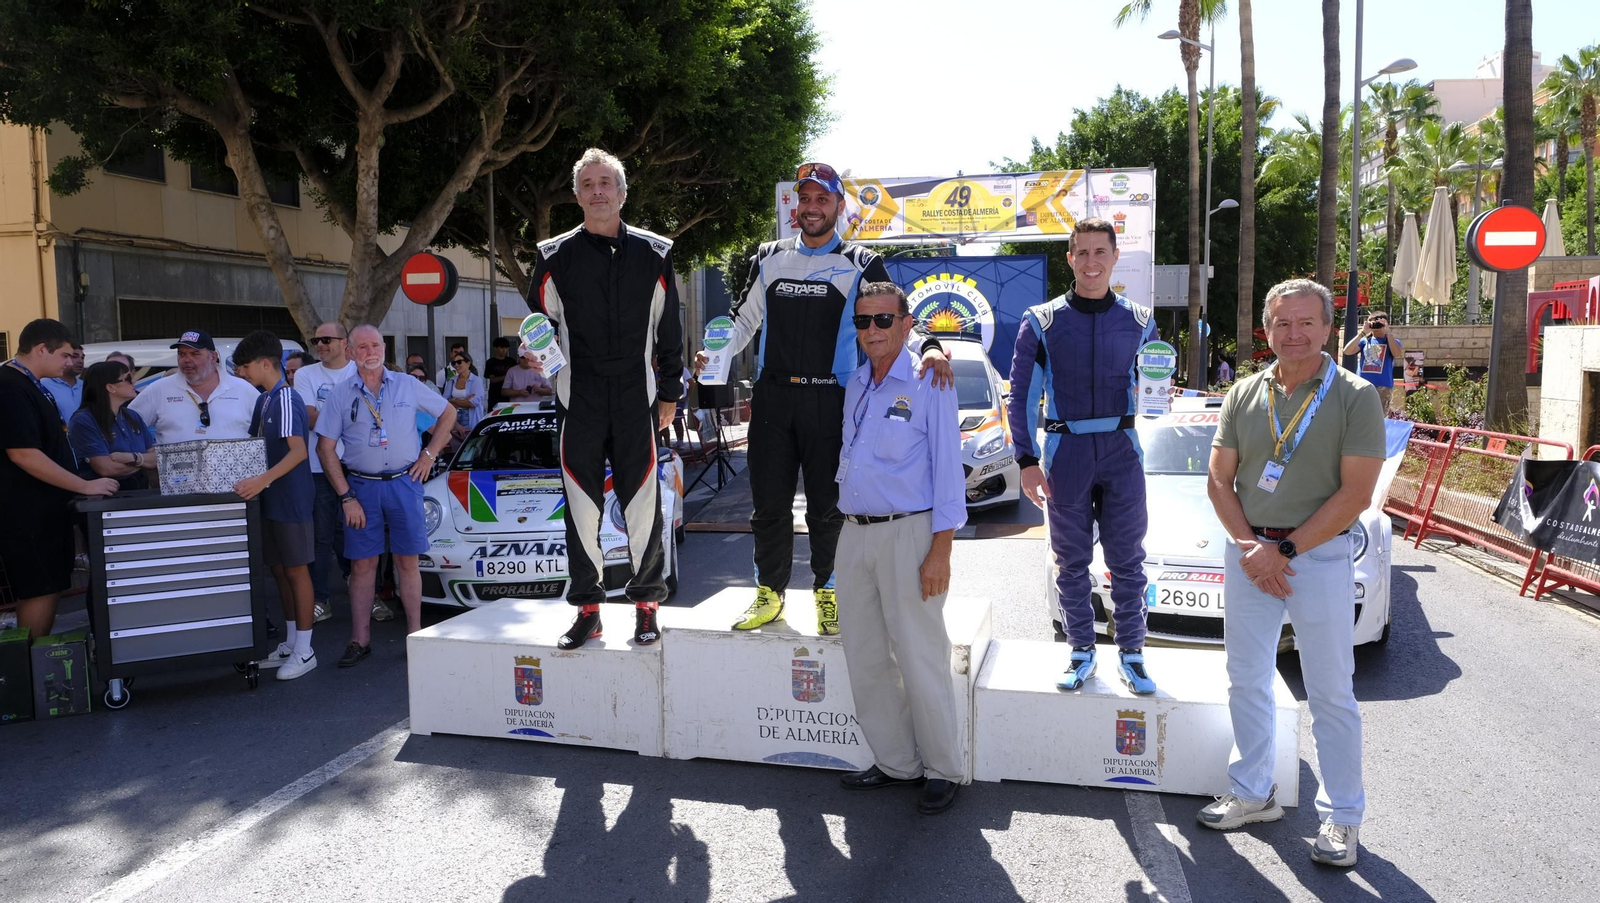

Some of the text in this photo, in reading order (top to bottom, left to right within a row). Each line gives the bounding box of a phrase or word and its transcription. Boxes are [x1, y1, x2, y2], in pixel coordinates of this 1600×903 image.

[944, 185, 972, 208] 49
[922, 206, 999, 217] RALLYE COSTA DE ALMERÍA
[859, 224, 892, 232] ALMERÍA
[543, 245, 556, 253] OMP
[652, 242, 665, 251] OMP
[775, 281, 828, 294] ASTARS
[908, 283, 988, 316] UTOMOVIL CLUB
[526, 322, 549, 342] Rally
[707, 328, 729, 339] Rally
[531, 331, 551, 347] Challenge
[1143, 354, 1172, 368] Rally
[1142, 366, 1171, 374] Challenge
[498, 425, 536, 433] MOTOR
[499, 417, 547, 429] André
[1556, 531, 1599, 548] deslumbrante
[469, 542, 567, 561] AZNAR
[486, 558, 564, 575] 8290 KTL
[1160, 572, 1225, 582] PRO RALL
[481, 582, 560, 595] PRORALLYE
[1160, 588, 1210, 609] 2690
[504, 708, 555, 719] DIPUTACIÓN
[506, 717, 554, 728] DE ALMERÍA
[759, 724, 860, 745] DE ALMERÍA
[1103, 758, 1158, 767] DIPUTACIÓN
[1104, 766, 1156, 776] DE ALMERÍA
